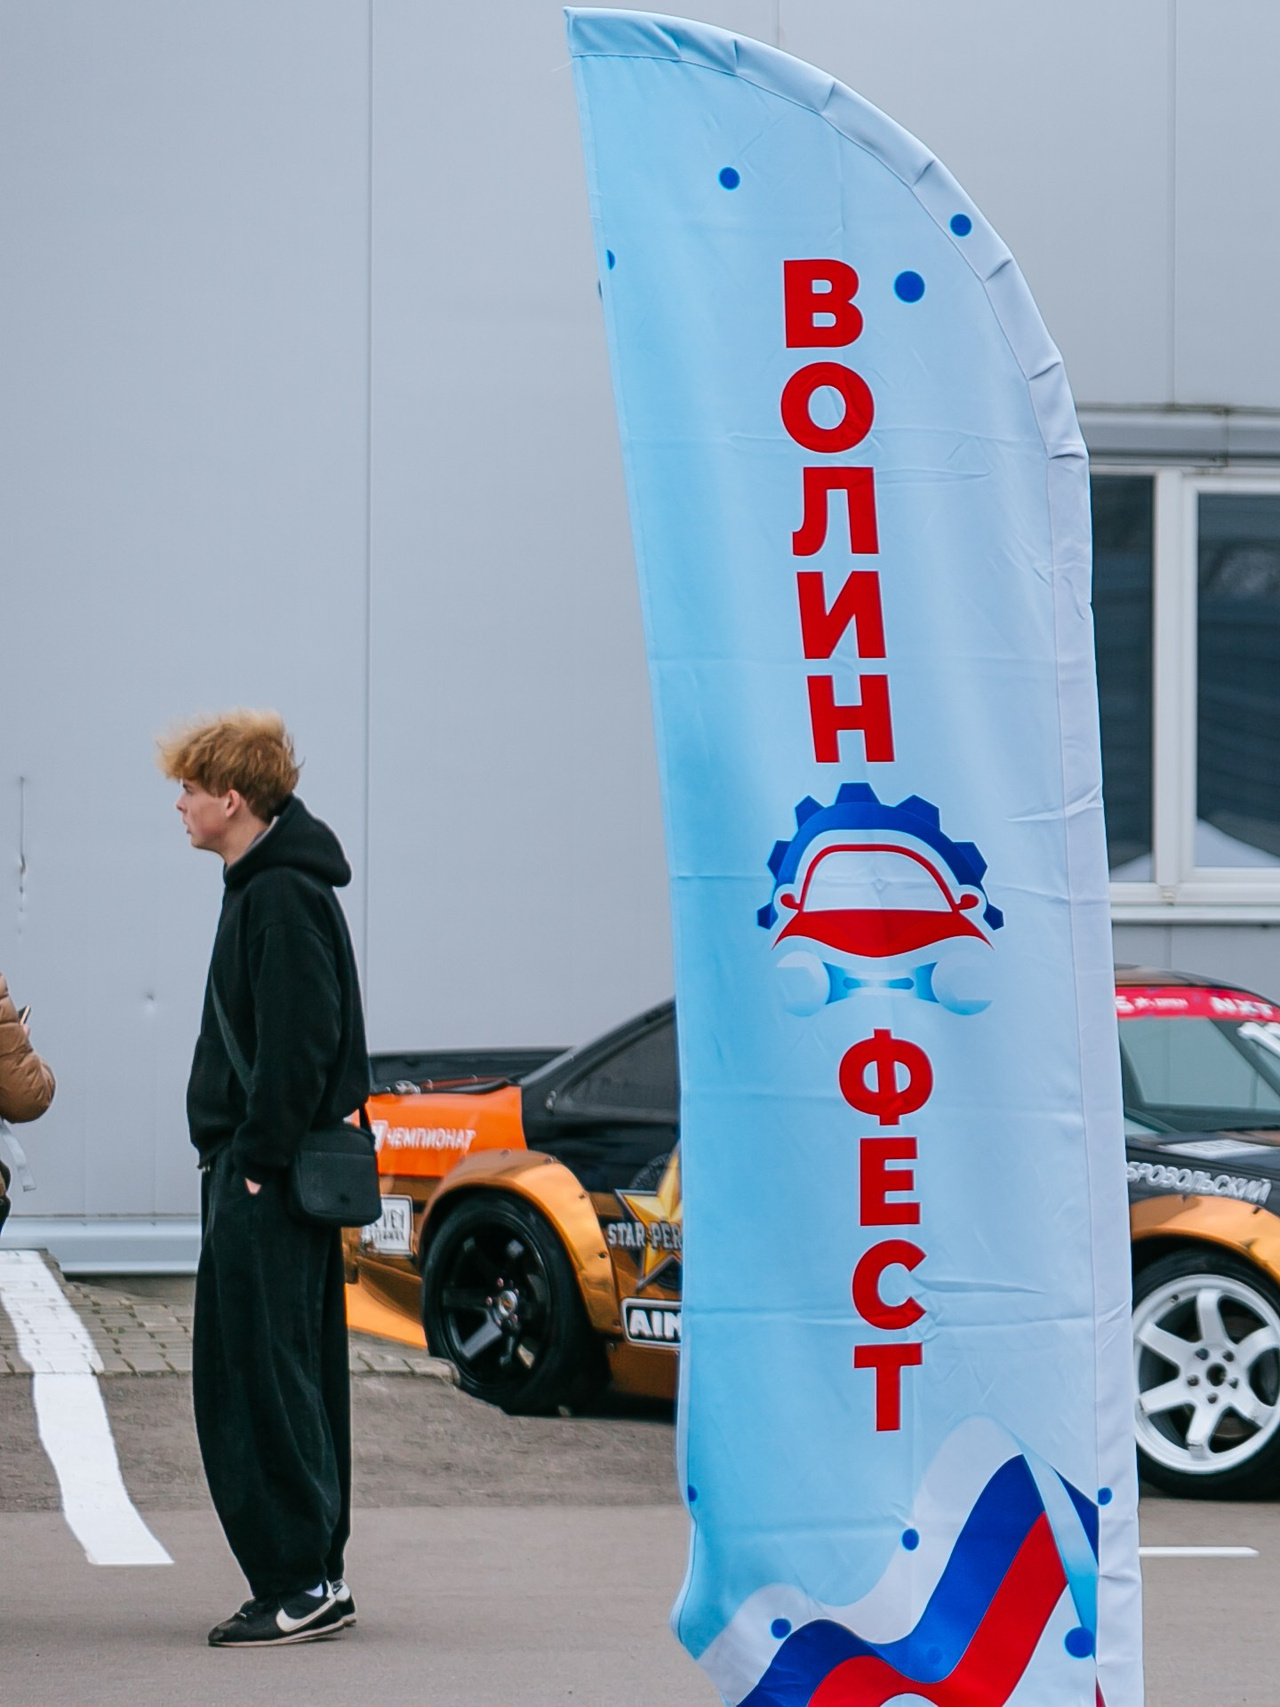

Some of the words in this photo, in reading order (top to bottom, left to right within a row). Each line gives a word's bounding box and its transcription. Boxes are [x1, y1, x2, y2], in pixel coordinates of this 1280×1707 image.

[780, 258, 896, 764] ВОЛИН
[628, 1308, 682, 1338] AIM
[650, 1220, 682, 1250] PER
[838, 1028, 934, 1432] ФЕСТ
